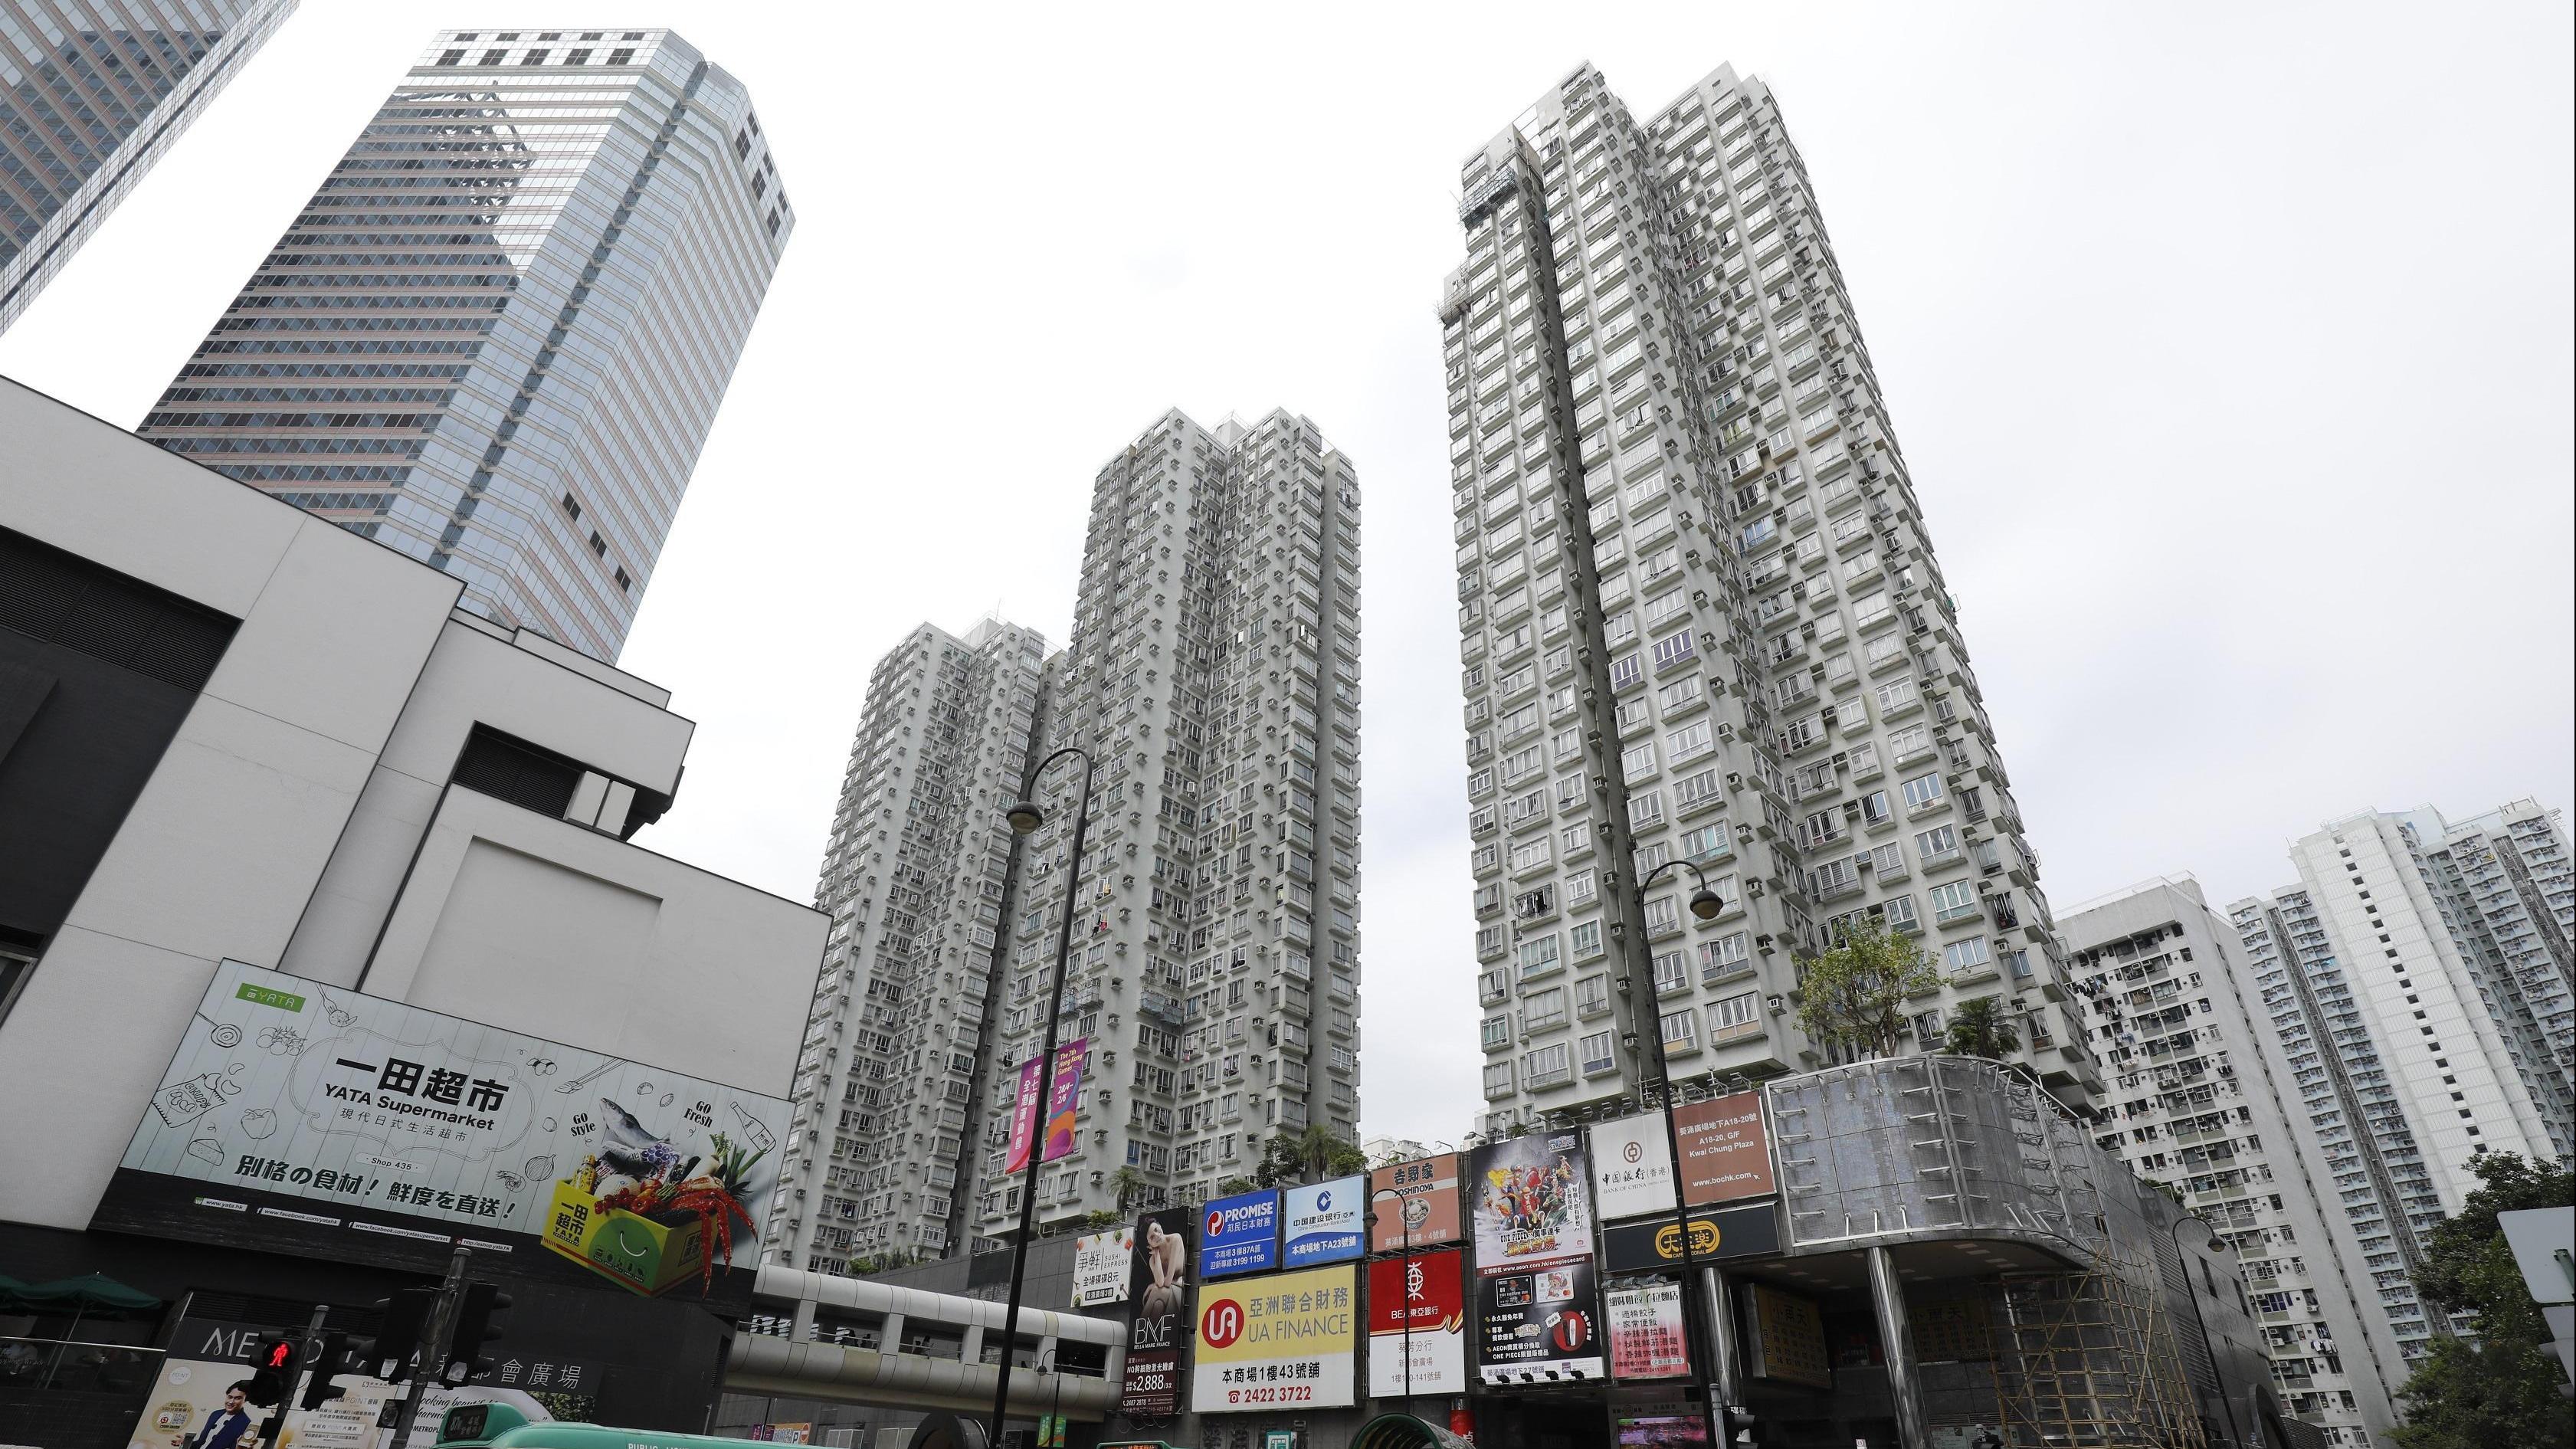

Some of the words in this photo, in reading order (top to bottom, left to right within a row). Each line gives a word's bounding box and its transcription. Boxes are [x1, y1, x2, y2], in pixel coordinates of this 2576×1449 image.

[259, 991, 296, 1008] YATA
[1069, 1048, 1077, 1057] 7th
[1058, 1059, 1071, 1069] Hong
[1071, 1054, 1083, 1064] Kong
[1057, 1065, 1073, 1075] Games
[336, 1057, 510, 1113] 一田超市
[183, 1082, 211, 1110] CHIPS
[325, 1083, 372, 1105] YATA
[376, 1096, 495, 1131] Supermarket
[696, 1100, 712, 1114] GO
[340, 1107, 467, 1143] 現代日式生活超市
[573, 1113, 588, 1125] GO
[683, 1107, 713, 1129] Fresh
[571, 1123, 596, 1137] Style
[1699, 1134, 1726, 1145] A18-20,
[1727, 1130, 1741, 1139] G/F
[1734, 1140, 1755, 1149] Plaza
[371, 1157, 392, 1168] Shop
[395, 1161, 412, 1170] 435
[1692, 1172, 1752, 1187] www.bochk.com
[205, 1198, 244, 1211] www.yata.hk
[1225, 1201, 1273, 1222] PROMISE
[264, 1208, 338, 1225] www.facebook.com/yatahk
[355, 1223, 449, 1242] www.facebook.com/yatasupermarket
[1227, 1217, 1271, 1233] 邦民日本財務
[555, 1227, 580, 1243] YATA
[1500, 1234, 1511, 1243] ONE
[1103, 1259, 1128, 1269] EXPRESS
[1250, 1254, 1265, 1263] 1199
[1503, 1255, 1585, 1272] www.aeon.com.hk/onepiececard
[1249, 1287, 1349, 1318] 亞洲聯合財務
[1410, 1306, 1439, 1317] 東亞銀行
[1134, 1314, 1172, 1345] BMF
[1248, 1323, 1270, 1342] UA
[1276, 1313, 1349, 1340] FINANCE
[1221, 1361, 1320, 1384] 本商場1樓43號舖
[1244, 1388, 1275, 1403] 2422
[1279, 1385, 1312, 1401] 3722
[421, 1395, 451, 1410] ooking
